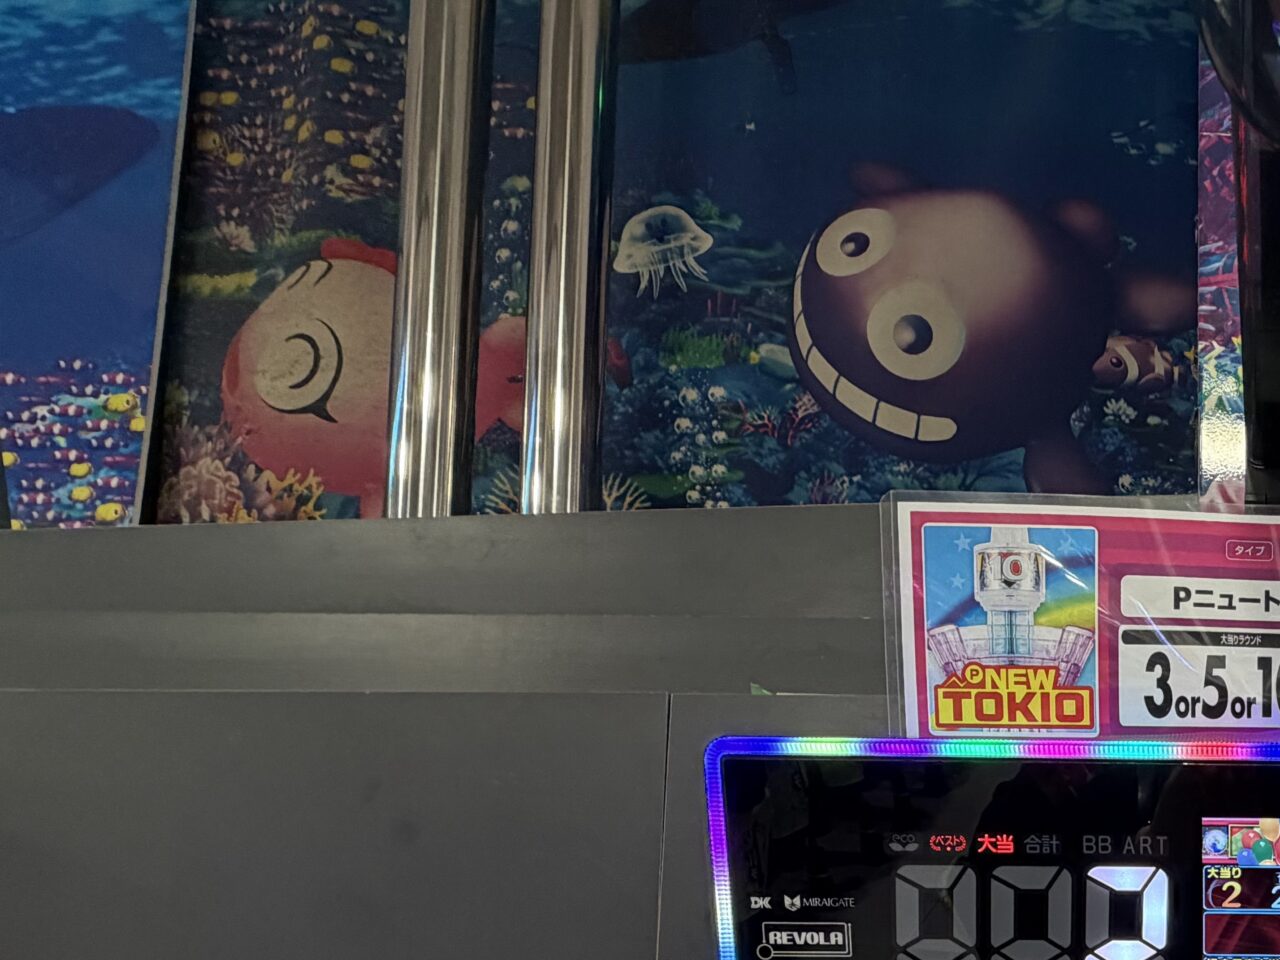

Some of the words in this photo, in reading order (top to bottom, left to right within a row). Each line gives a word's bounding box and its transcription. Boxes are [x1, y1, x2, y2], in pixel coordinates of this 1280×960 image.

[1234, 545, 1266, 556] タイプ
[1219, 633, 1263, 646] 大当りラウンド
[985, 668, 1055, 690] NEW
[943, 691, 1085, 722] TOKIO
[935, 834, 960, 847] ベスト
[977, 834, 1015, 853] 大当
[1024, 835, 1061, 853] 合計
[1083, 835, 1112, 854] BB
[1122, 835, 1168, 854] ART
[1207, 867, 1242, 879] 大当り
[802, 897, 855, 908] MIRAIGATE
[1220, 880, 1242, 908] 2
[768, 929, 844, 946] REVOLA
